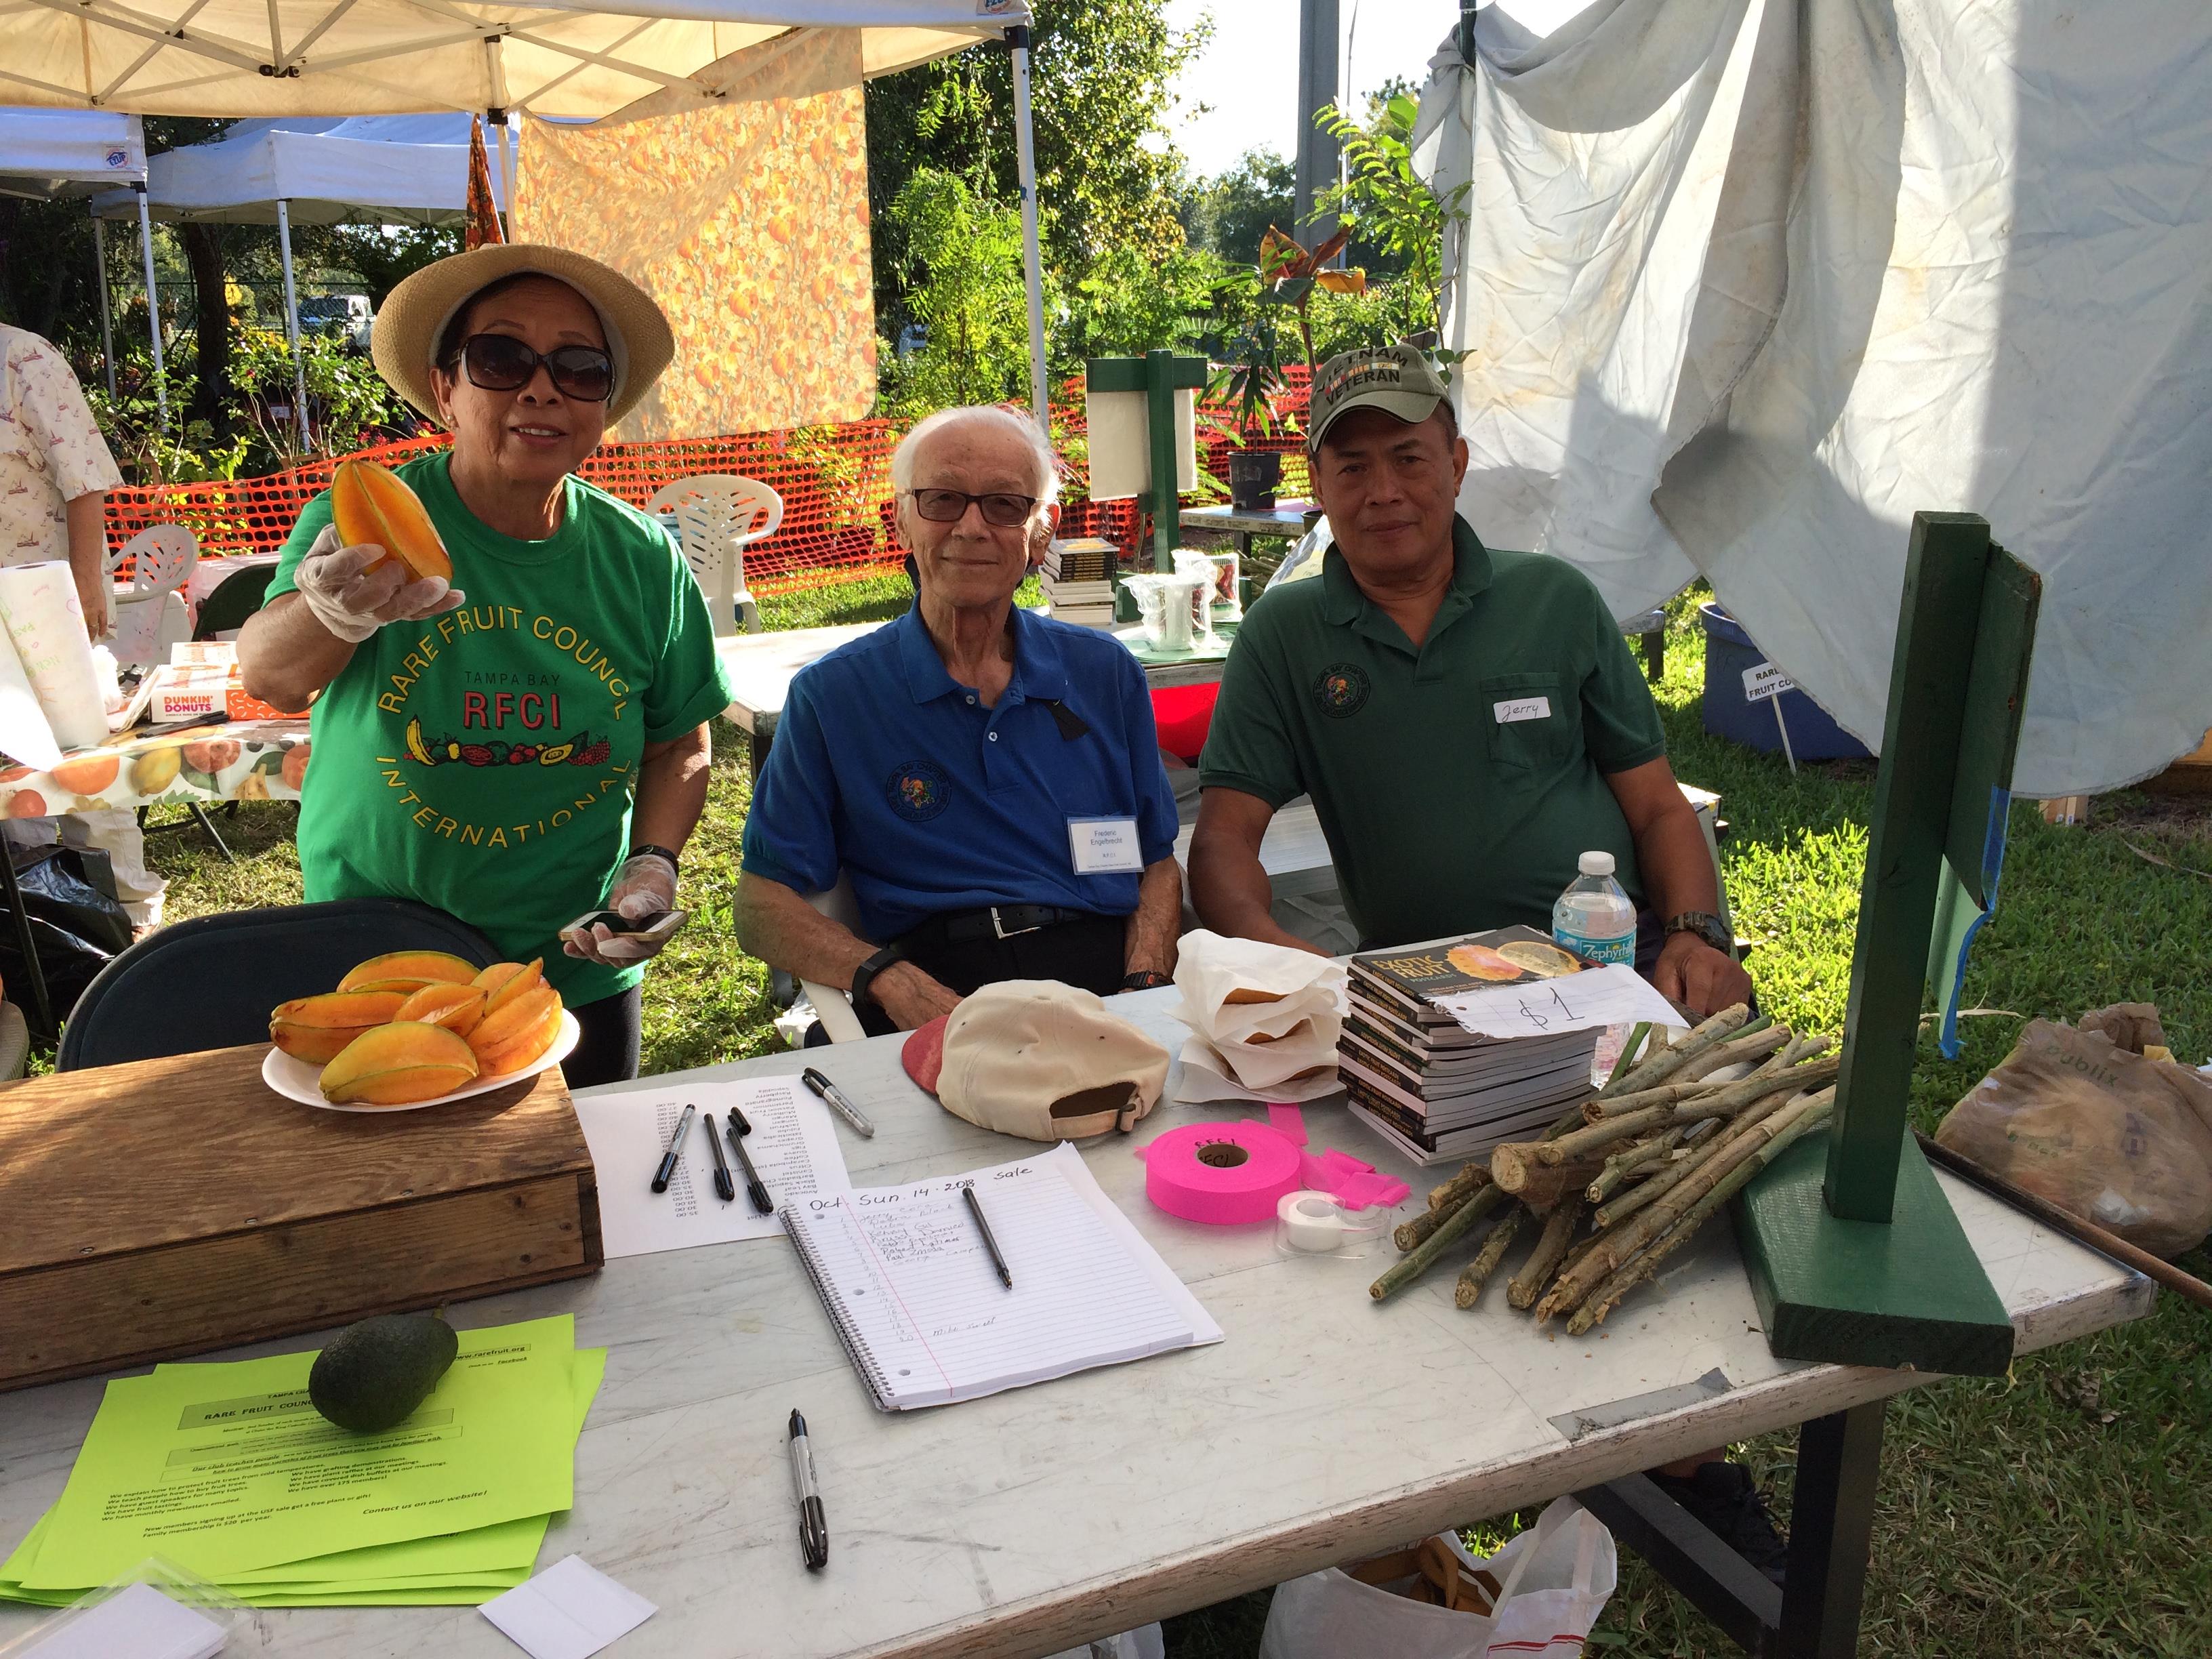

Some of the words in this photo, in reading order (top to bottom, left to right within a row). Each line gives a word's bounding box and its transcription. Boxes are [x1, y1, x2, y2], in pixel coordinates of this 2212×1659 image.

[1317, 348, 1408, 393] VIETNAM
[1326, 370, 1400, 406] VETERAN
[377, 634, 439, 714] RARE
[436, 605, 523, 644] FRUIT
[465, 671, 519, 686] TAMPA
[527, 674, 560, 687] BAY
[1749, 682, 1776, 698] FRUIT
[164, 696, 213, 704] DUNKIN'
[165, 703, 212, 712] DONUTS
[463, 691, 562, 731] RFCI
[1502, 705, 1539, 722] Jerry
[376, 756, 631, 848] INTERNATIONAL
[1090, 838, 1123, 846] Engelbrecht
[1372, 955, 1444, 970] EXOTIC
[1393, 964, 1451, 979] FRUIT
[1410, 973, 1457, 983] POSTCARDS
[914, 1187, 928, 1198] 14
[268, 1391, 293, 1399] TAMPA
[204, 1411, 236, 1420] RARE
[241, 1405, 274, 1415] FRUIT
[351, 1475, 386, 1483] members!
[166, 1503, 208, 1512] newsletters
[363, 1506, 398, 1514] Contact
[447, 1490, 487, 1501] website!
[163, 1521, 197, 1529] members
[168, 1523, 214, 1534] membership
